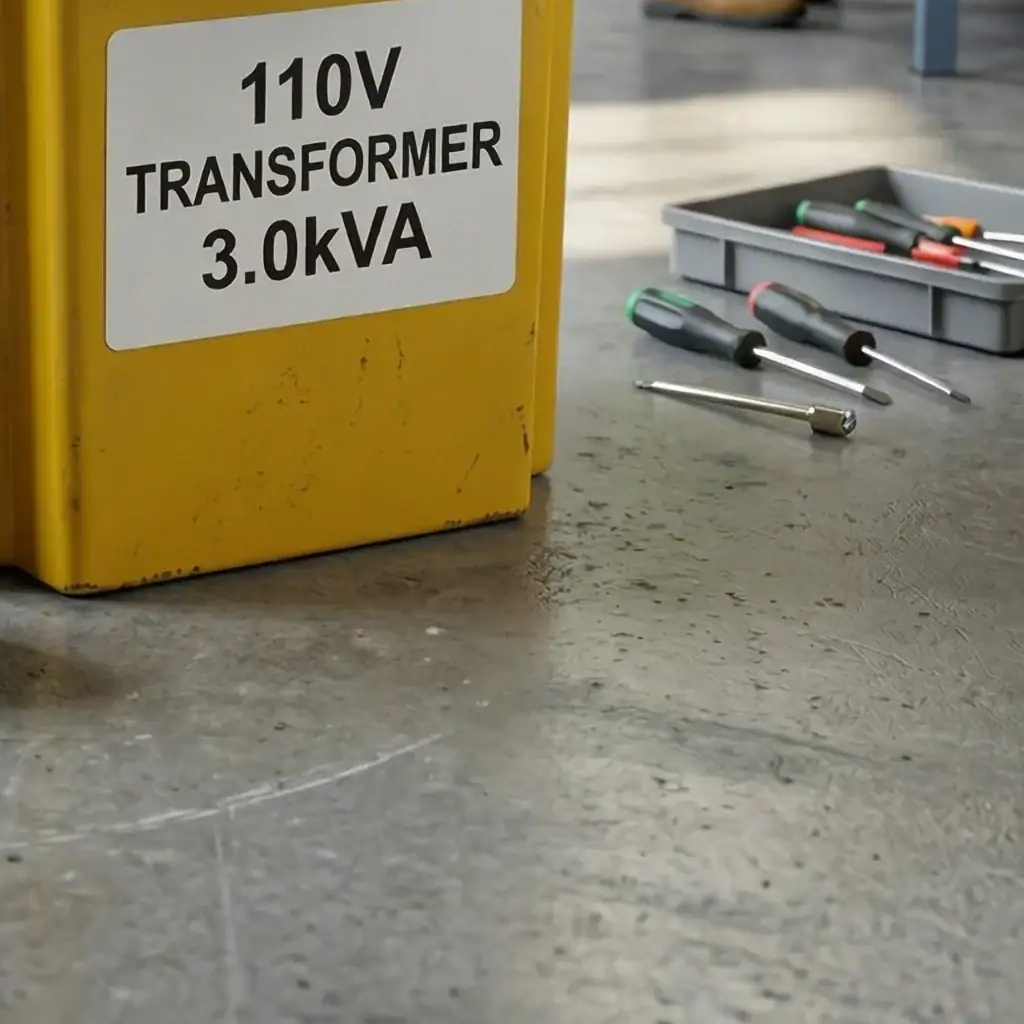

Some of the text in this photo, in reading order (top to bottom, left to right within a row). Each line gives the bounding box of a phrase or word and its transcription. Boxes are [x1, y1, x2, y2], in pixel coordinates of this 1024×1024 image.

[242, 46, 402, 125] 110V
[126, 120, 503, 215] TRANSFORMER
[202, 201, 433, 290] 3.0kVA
